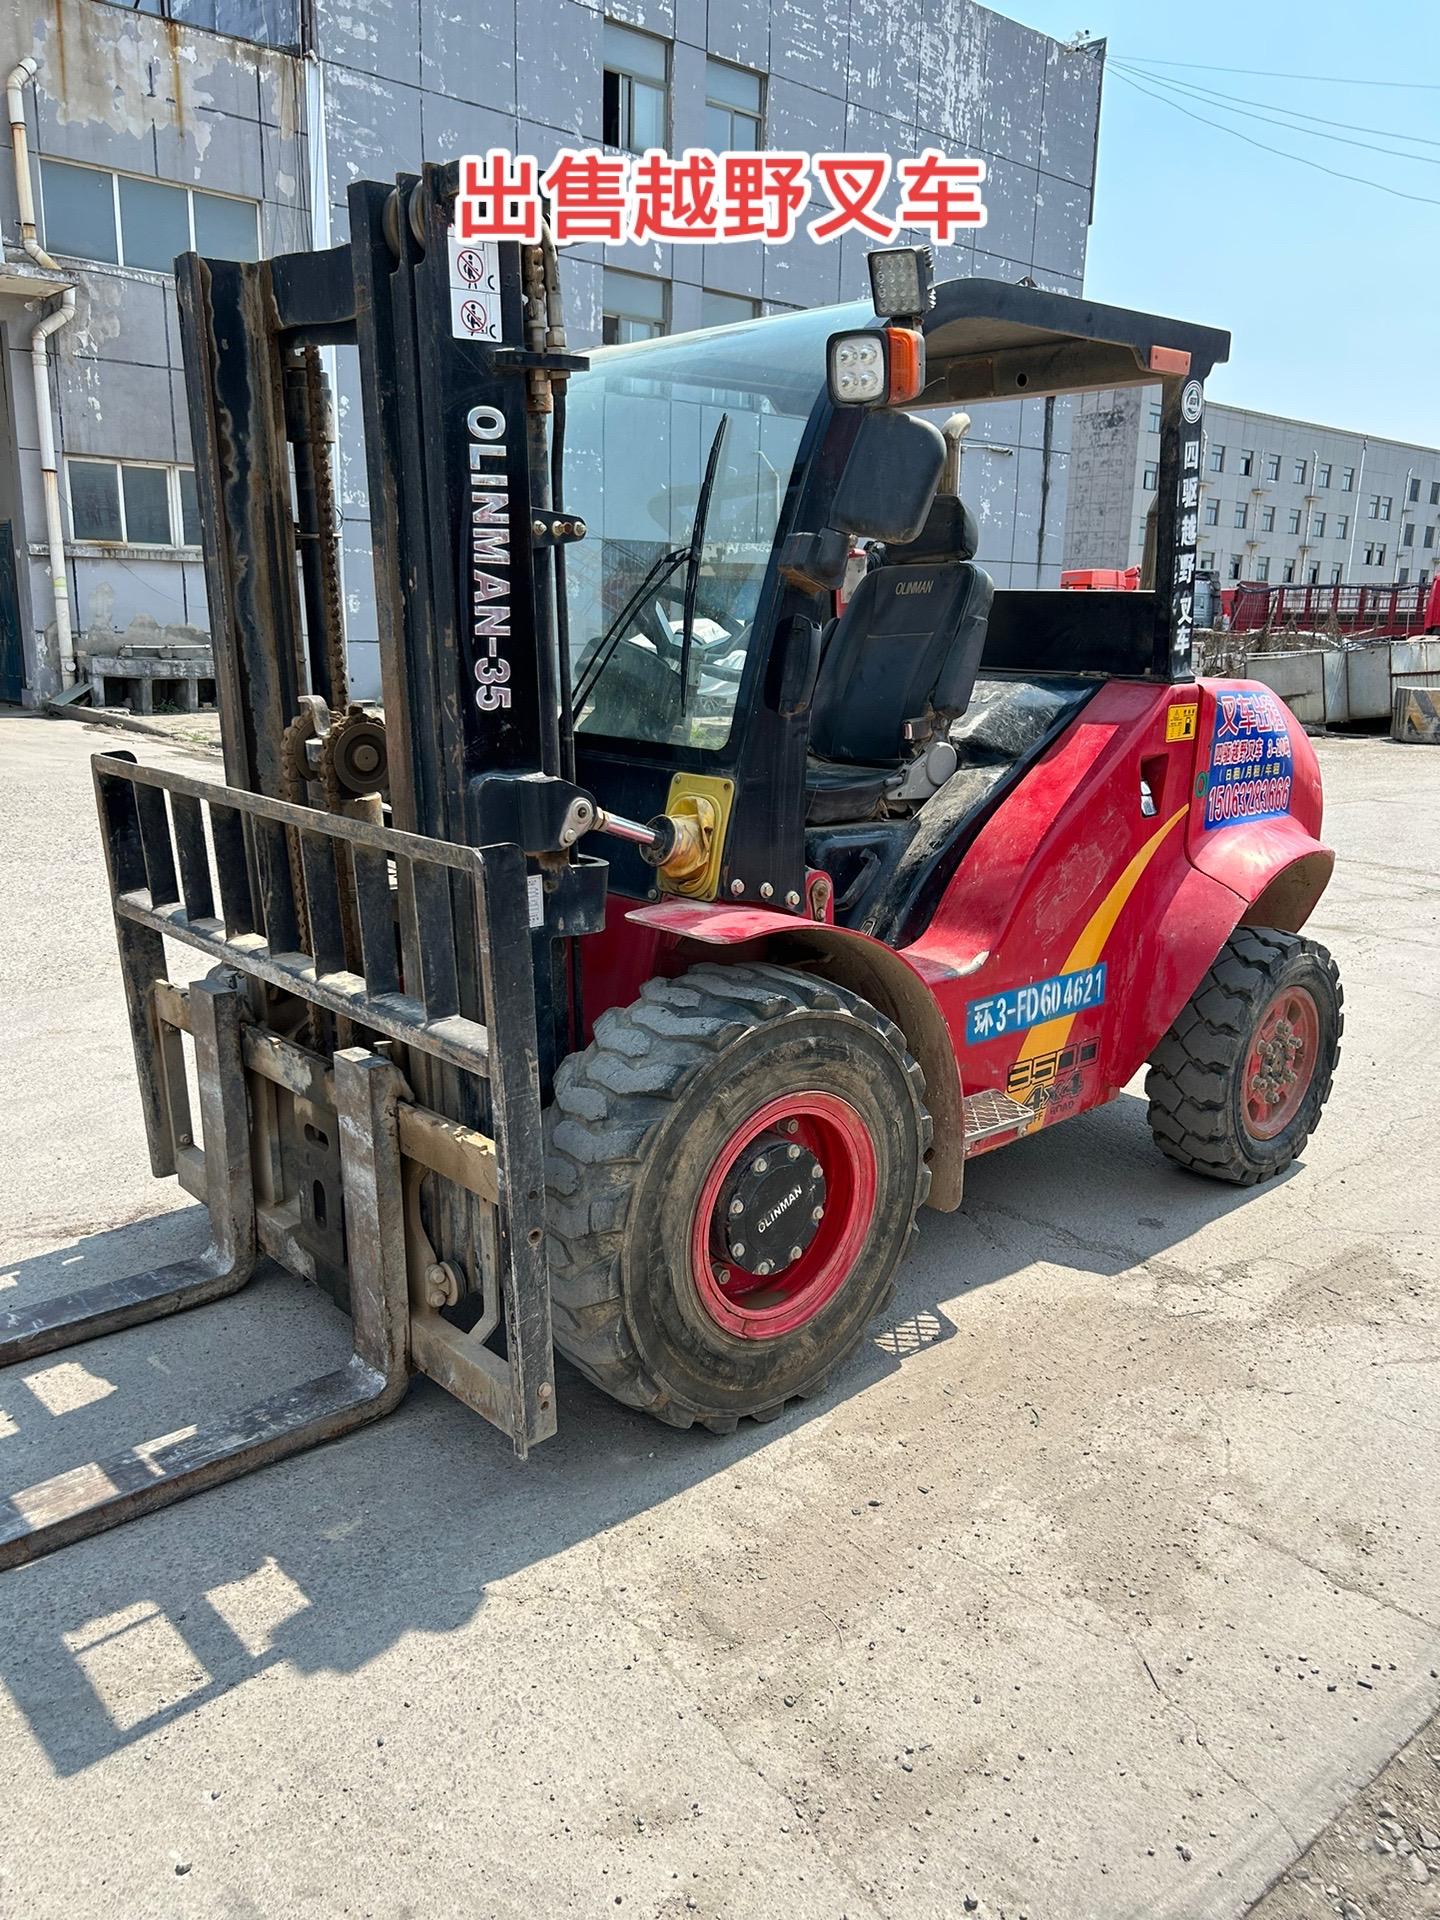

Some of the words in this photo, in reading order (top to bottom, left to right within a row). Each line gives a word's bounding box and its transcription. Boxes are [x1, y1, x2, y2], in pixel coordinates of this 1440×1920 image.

[467, 405, 511, 711] OLINMAN-35
[1173, 440, 1199, 656] 四驱越野叉车
[895, 580, 934, 596] OLINMAN
[1208, 776, 1291, 822] 15063283666
[758, 1184, 803, 1233] OLINMAN
